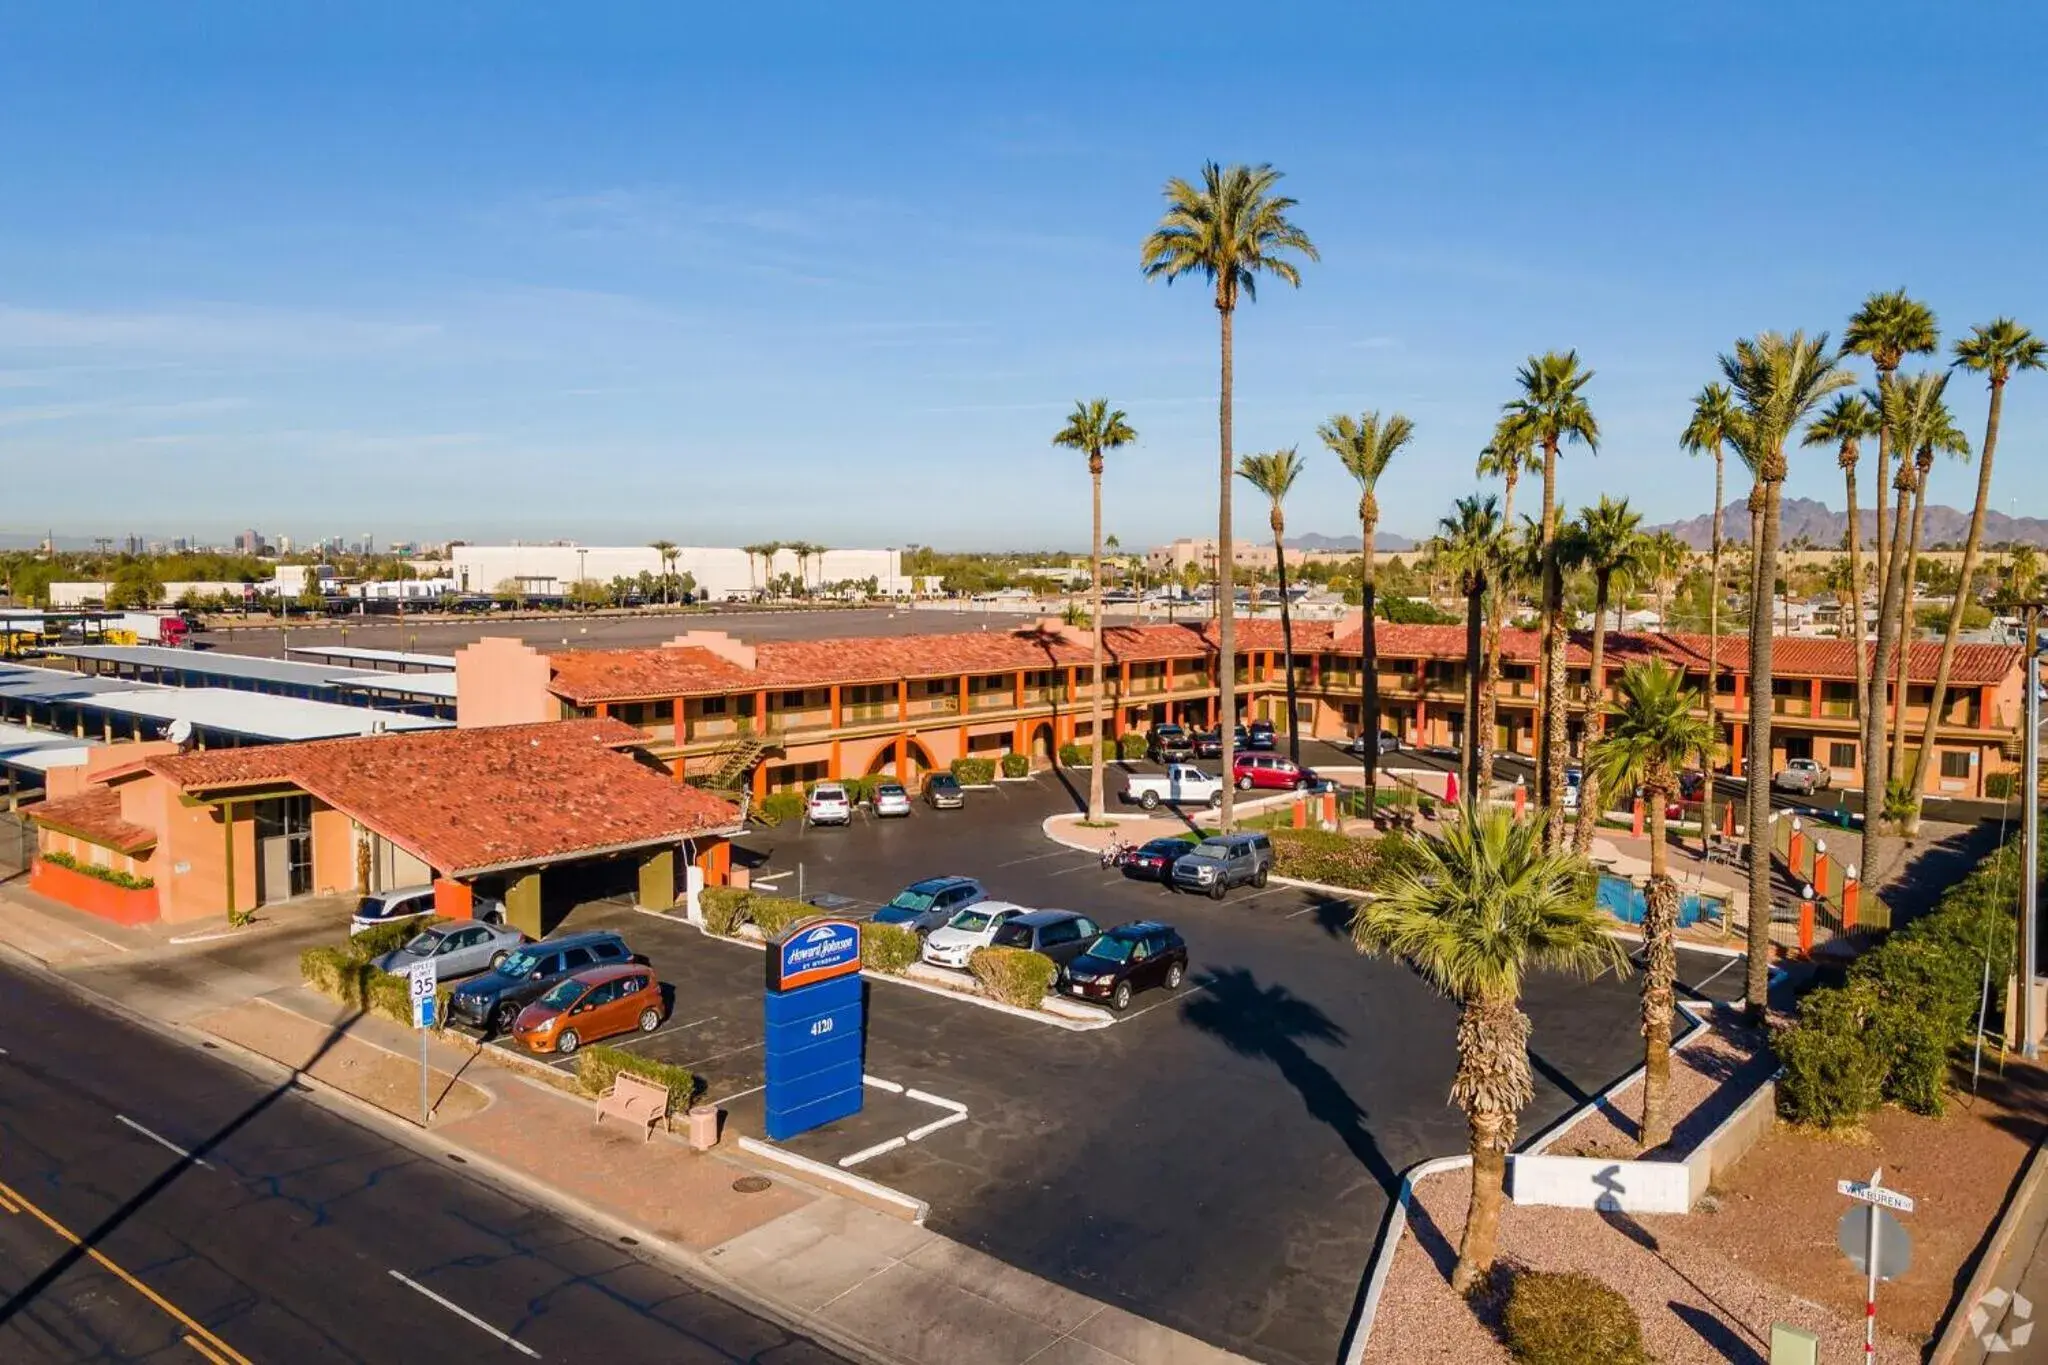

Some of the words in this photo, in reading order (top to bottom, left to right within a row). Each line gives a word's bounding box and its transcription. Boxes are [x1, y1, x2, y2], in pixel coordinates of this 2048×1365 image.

[787, 943, 822, 965] Howard
[821, 937, 853, 958] Johnson
[414, 977, 433, 995] 35
[811, 1018, 833, 1035] 4120
[1867, 1191, 1901, 1206] BUREN
